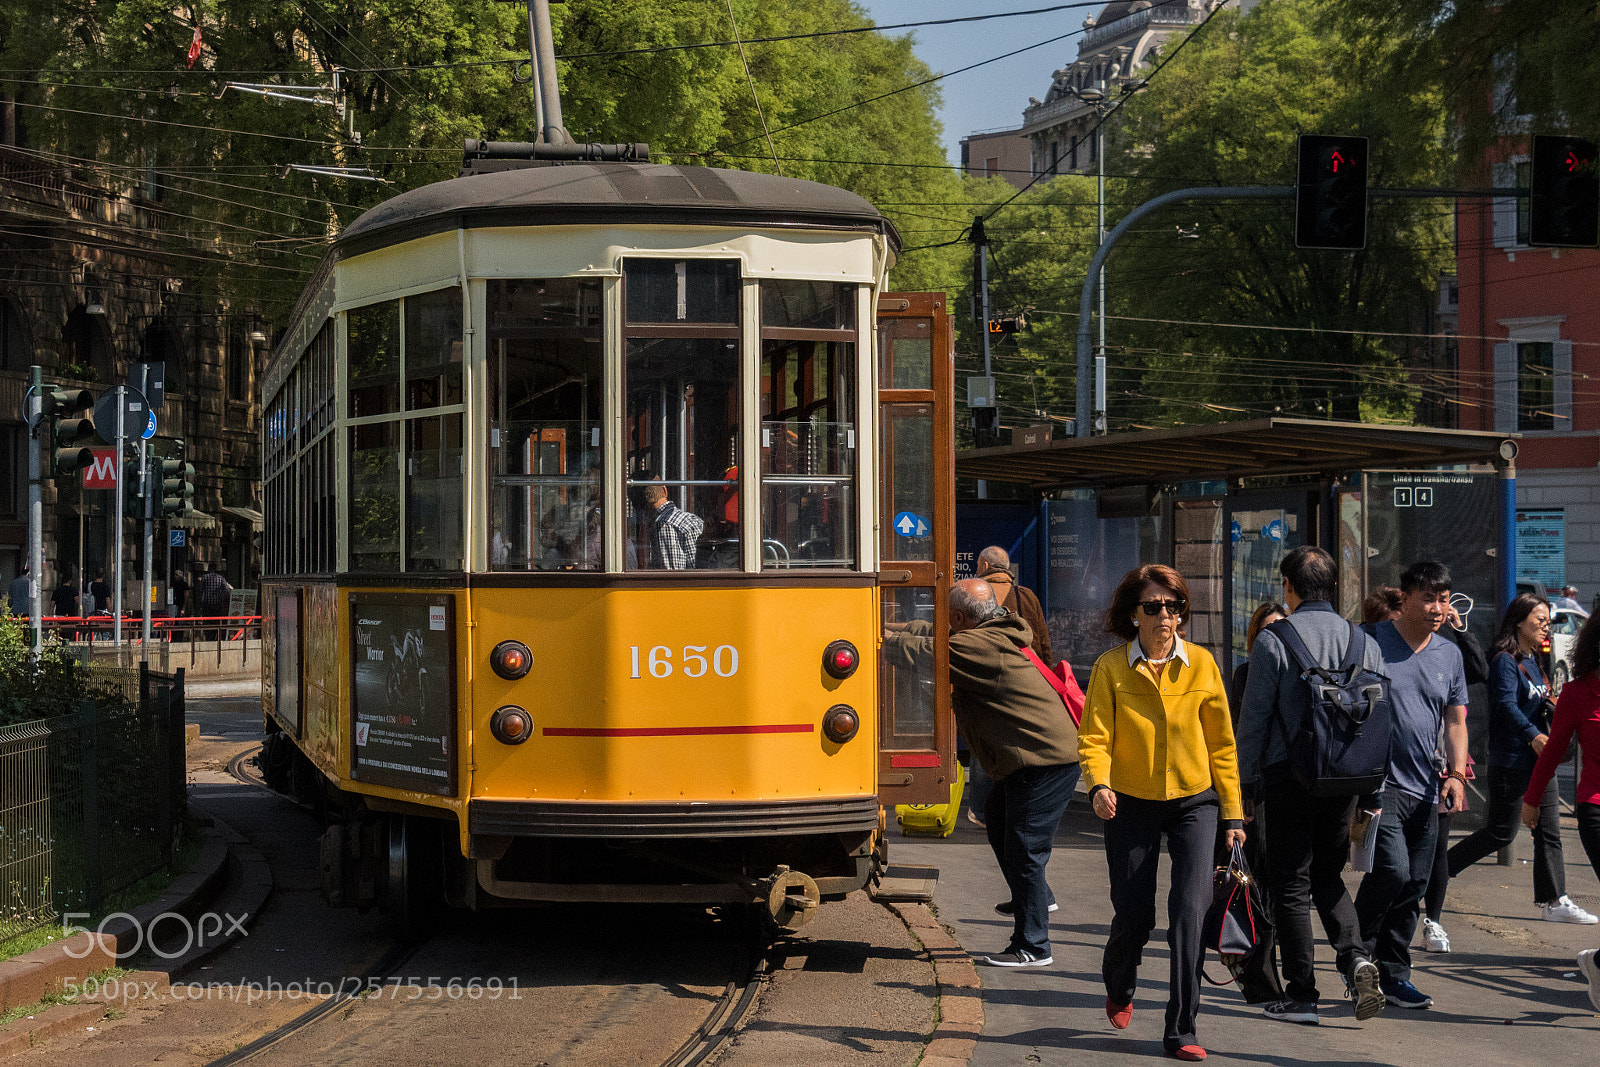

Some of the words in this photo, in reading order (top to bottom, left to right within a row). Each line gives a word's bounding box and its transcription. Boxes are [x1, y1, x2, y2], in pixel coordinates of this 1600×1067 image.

[86, 457, 117, 481] M
[1400, 492, 1406, 502] 1
[1420, 492, 1427, 502] 4
[630, 645, 739, 679] 1650
